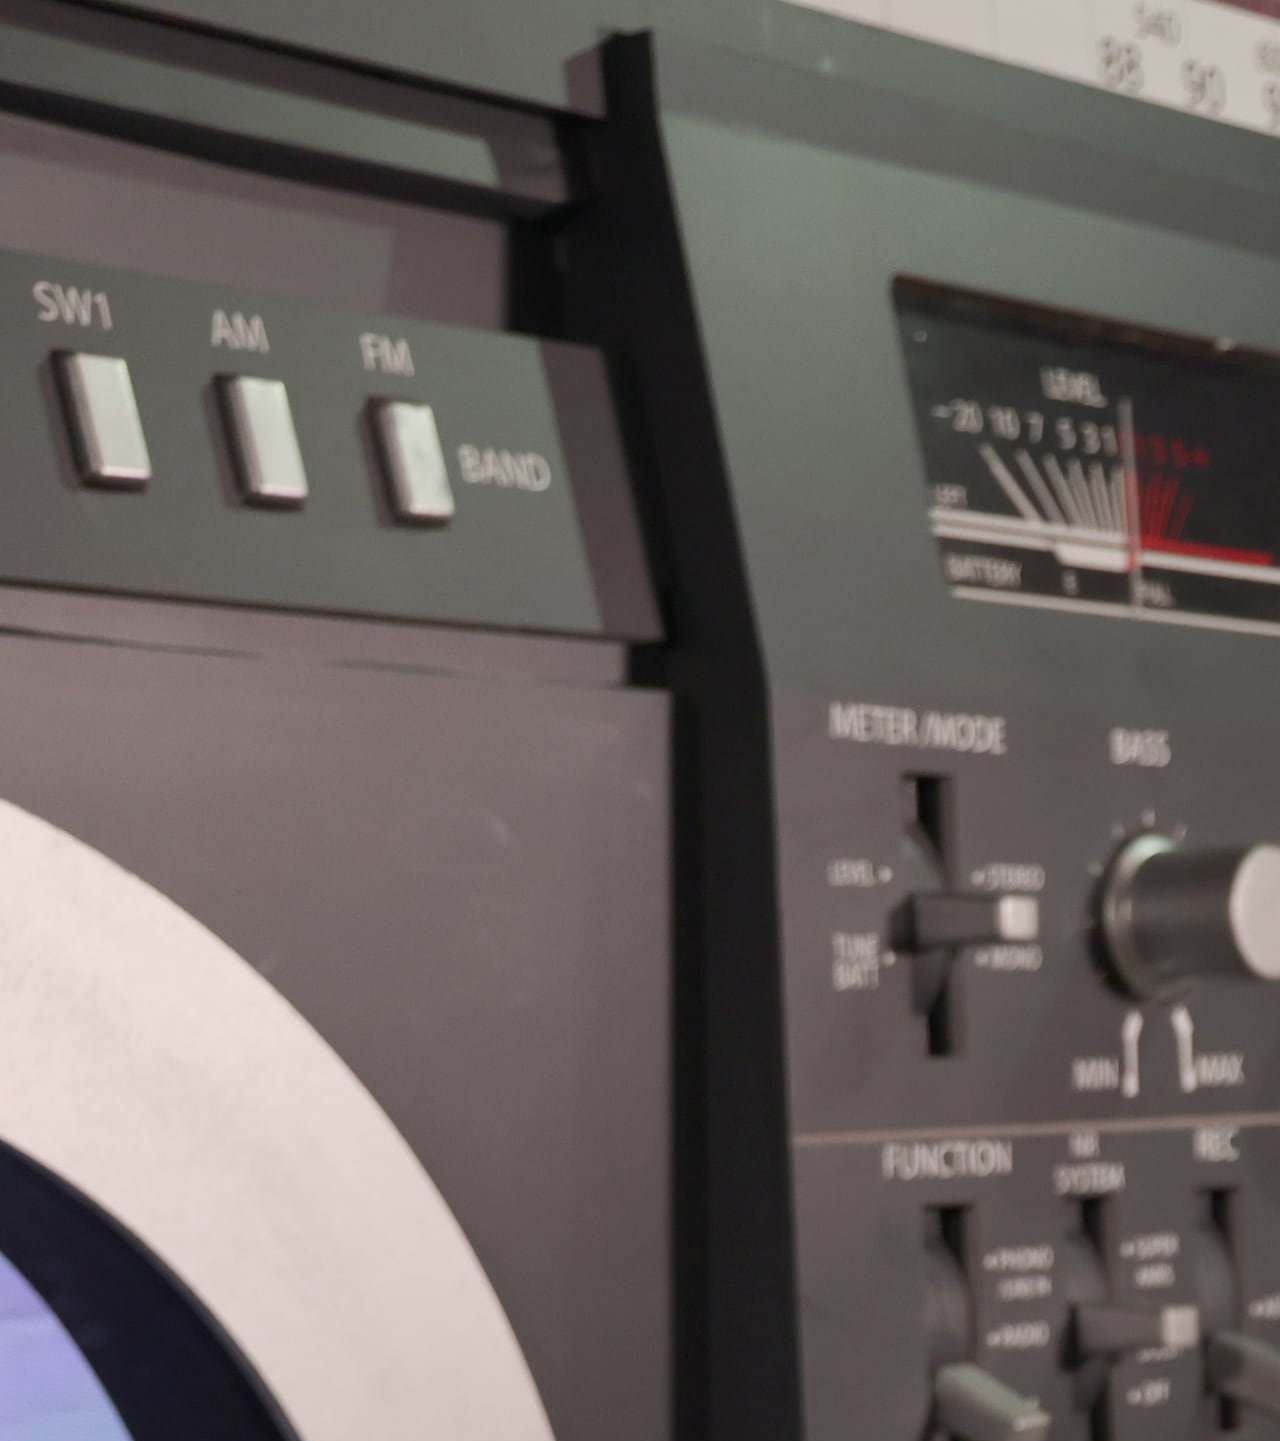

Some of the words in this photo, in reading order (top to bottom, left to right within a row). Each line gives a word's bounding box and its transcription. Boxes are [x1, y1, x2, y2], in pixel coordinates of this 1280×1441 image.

[33, 281, 113, 330] SW1
[211, 309, 270, 353] AM
[359, 333, 414, 376] FM
[1040, 366, 1108, 408] LEVEL
[457, 444, 551, 492] BAND
[943, 552, 1022, 588] BATTERY
[830, 702, 916, 747] METER
[1110, 727, 1172, 768] BASS
[1072, 1055, 1119, 1091] MIN
[1198, 1053, 1245, 1088] MAX
[882, 1140, 1013, 1181] FUNCTION
[1193, 1123, 1241, 1163] REC
[1052, 1161, 1126, 1197] SYSTEM
